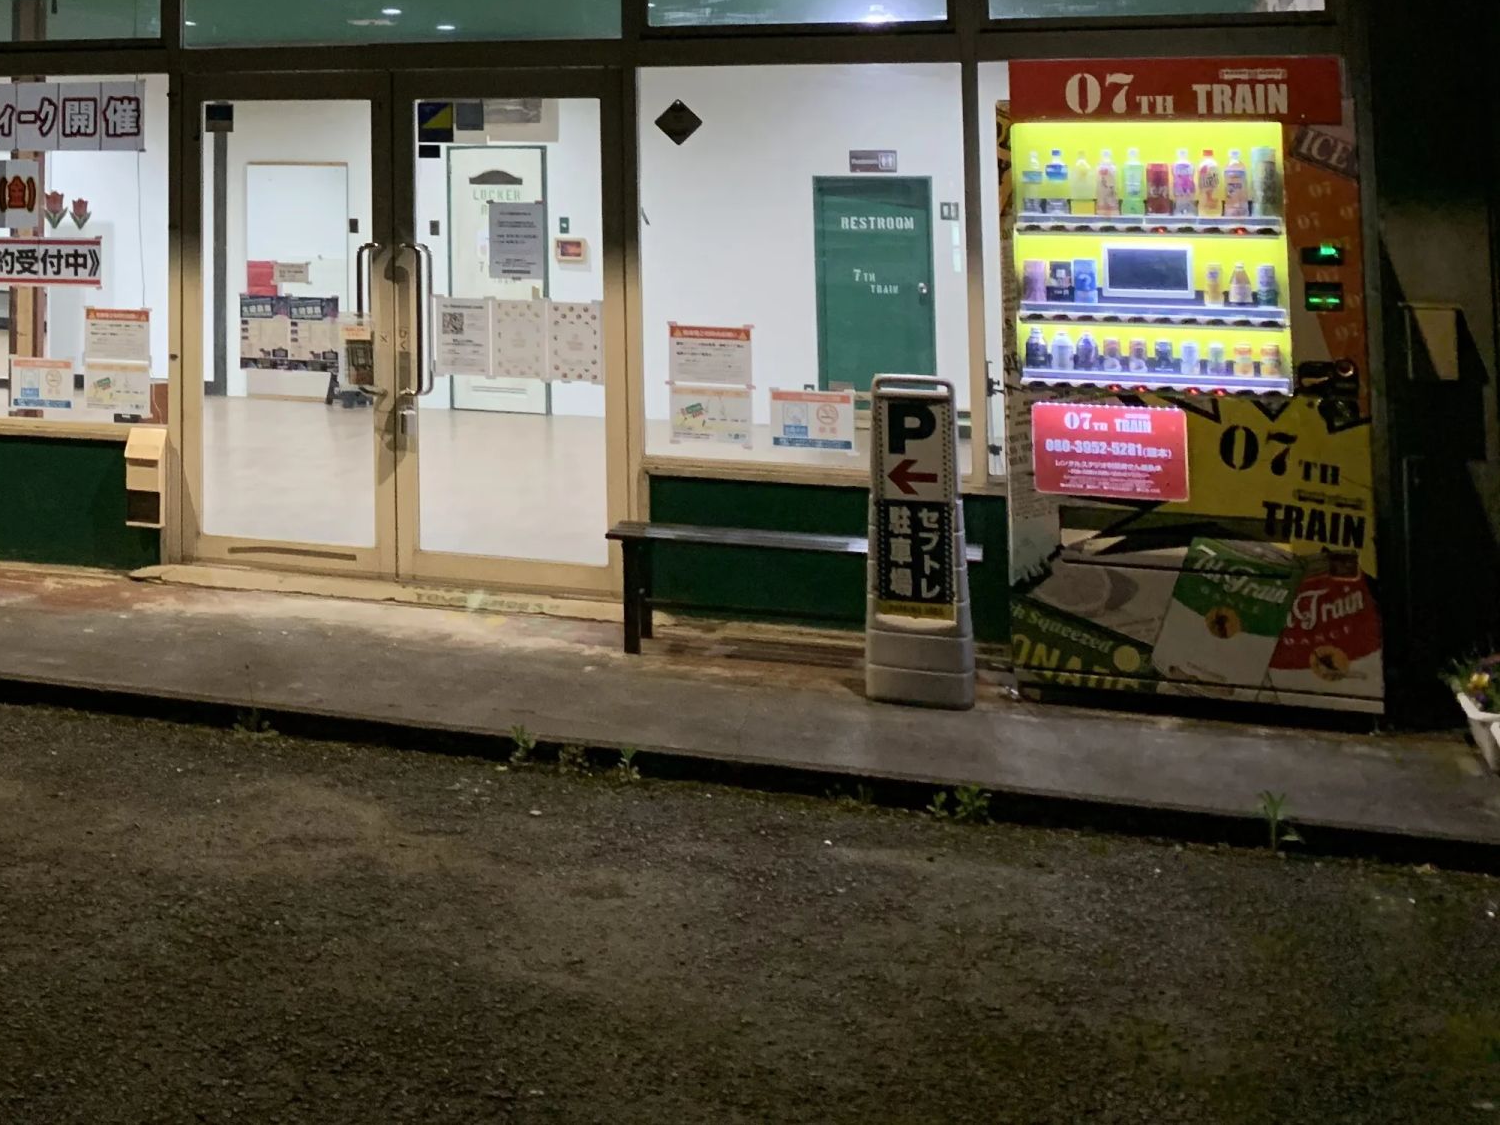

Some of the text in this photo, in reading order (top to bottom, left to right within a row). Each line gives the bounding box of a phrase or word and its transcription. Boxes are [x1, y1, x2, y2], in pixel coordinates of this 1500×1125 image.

[1192, 83, 1288, 115] TRAIN
[472, 189, 521, 201] LOCKER
[840, 216, 915, 230] RESTROOM
[870, 284, 899, 295] TRAIN
[888, 402, 937, 455] P
[1114, 417, 1153, 434] TRAIN
[1262, 500, 1366, 550] TRAIN
[888, 506, 913, 597] 駐車場
[1291, 585, 1365, 631] Train
[1028, 609, 1115, 654] Squeezed
